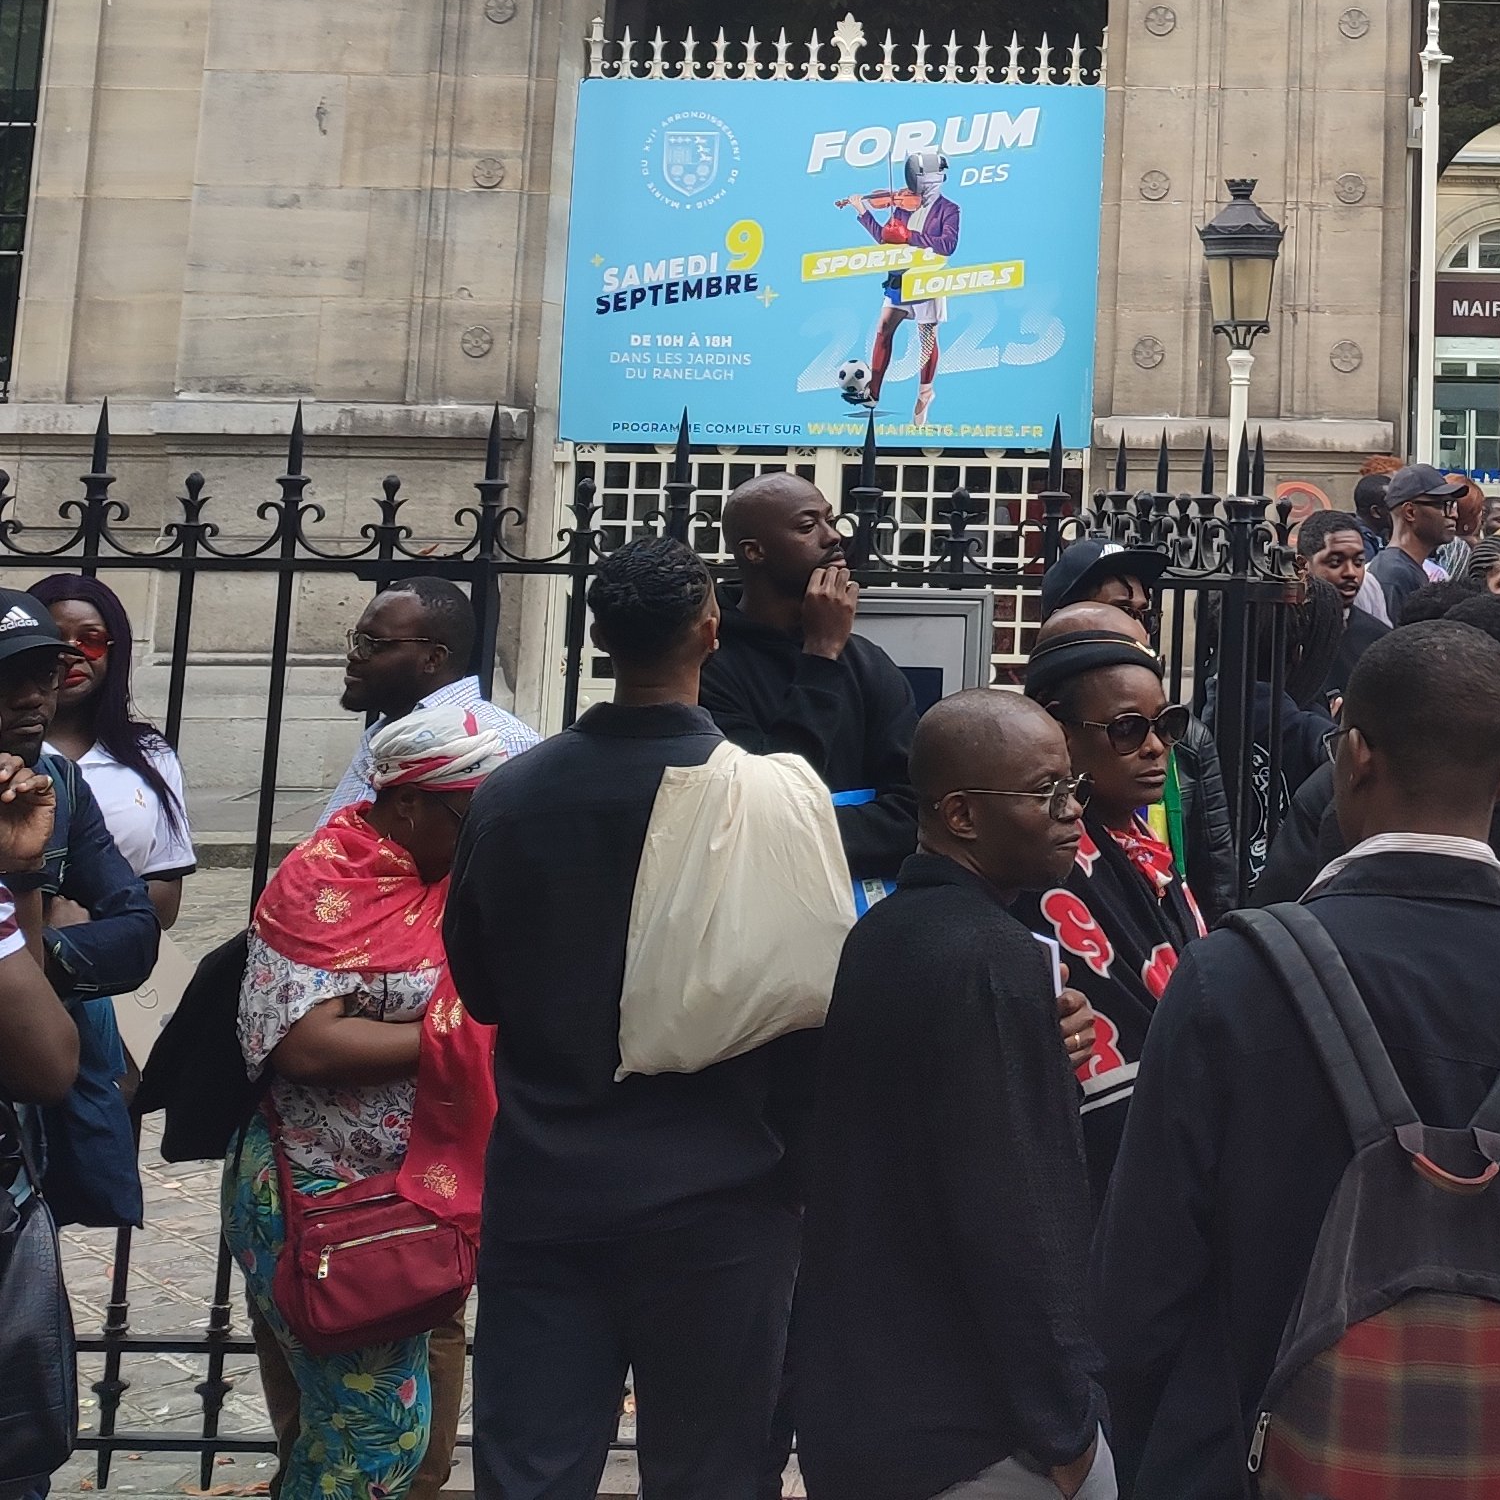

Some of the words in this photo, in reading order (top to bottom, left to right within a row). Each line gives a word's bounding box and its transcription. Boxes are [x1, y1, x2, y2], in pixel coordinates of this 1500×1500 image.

[807, 106, 1042, 175] FORUM
[960, 163, 1011, 187] DES
[602, 251, 718, 293] SAMEDI
[725, 218, 764, 272] 9
[811, 248, 917, 276] SPORTS
[911, 266, 1015, 297] LOISIRS
[595, 273, 759, 315] SEPTEMBRE
[630, 334, 651, 347] DE
[656, 334, 684, 348] 10H
[688, 331, 700, 347] À
[704, 334, 733, 348] 18H
[610, 352, 651, 364] DANS
[656, 353, 682, 365] LES
[686, 353, 752, 366] JARDINS
[626, 368, 647, 379] DU
[653, 368, 734, 381] RANELAGH
[705, 423, 770, 434] COMPLET
[774, 424, 801, 435] SUR
[0, 618, 39, 632] adidas
